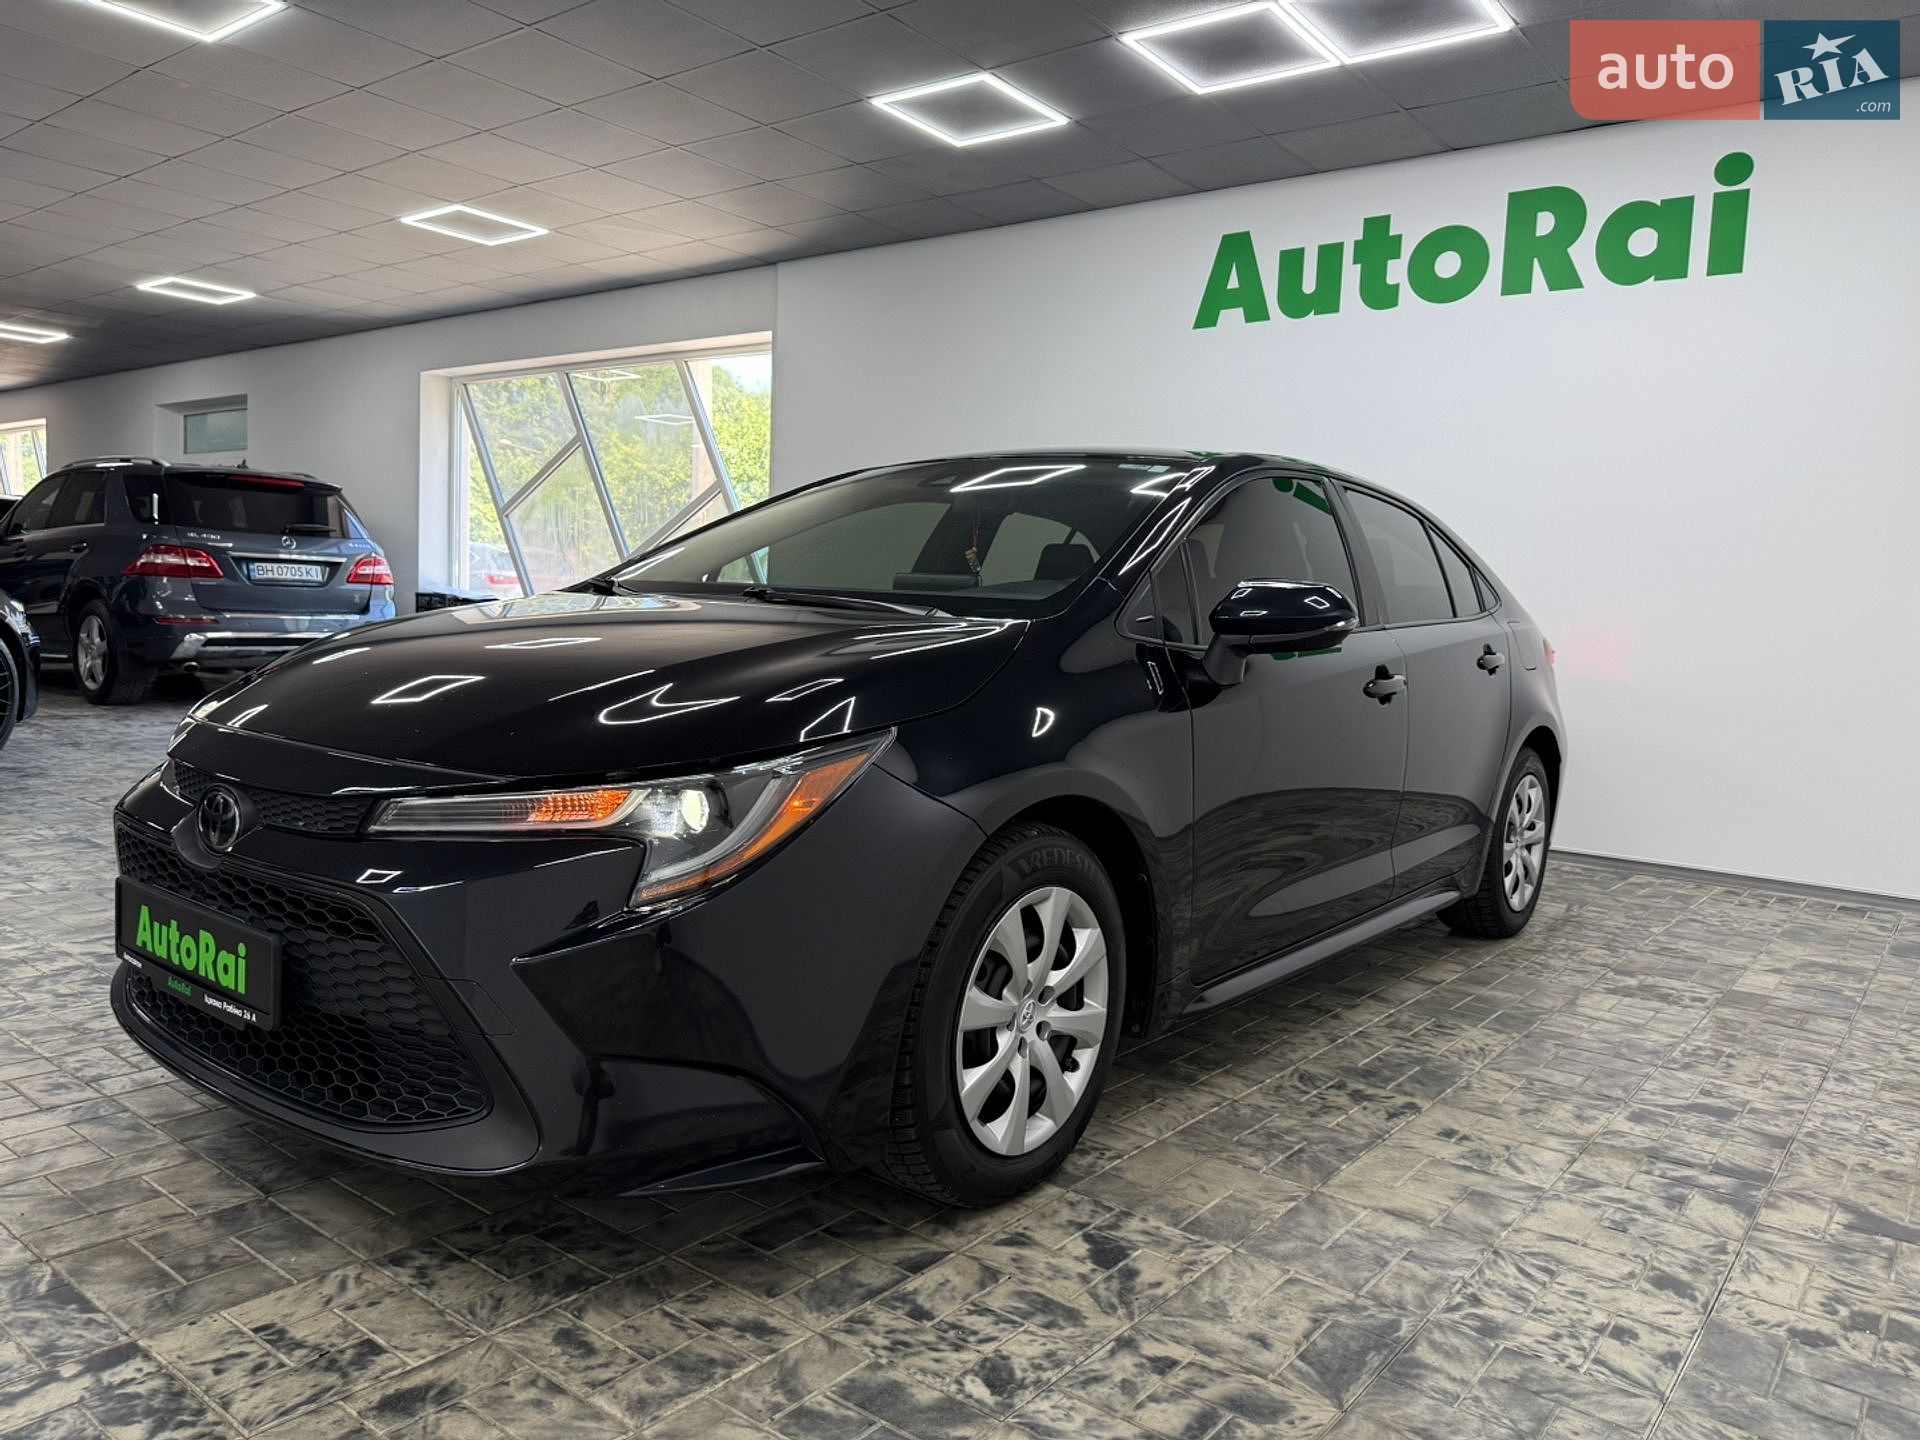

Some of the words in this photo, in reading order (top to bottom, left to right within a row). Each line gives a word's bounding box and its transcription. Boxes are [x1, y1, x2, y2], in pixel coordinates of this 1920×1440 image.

[1192, 151, 1755, 330] AutoRai
[256, 565, 275, 577] BH
[276, 566, 303, 577] 0705
[135, 904, 248, 995] AutoRai
